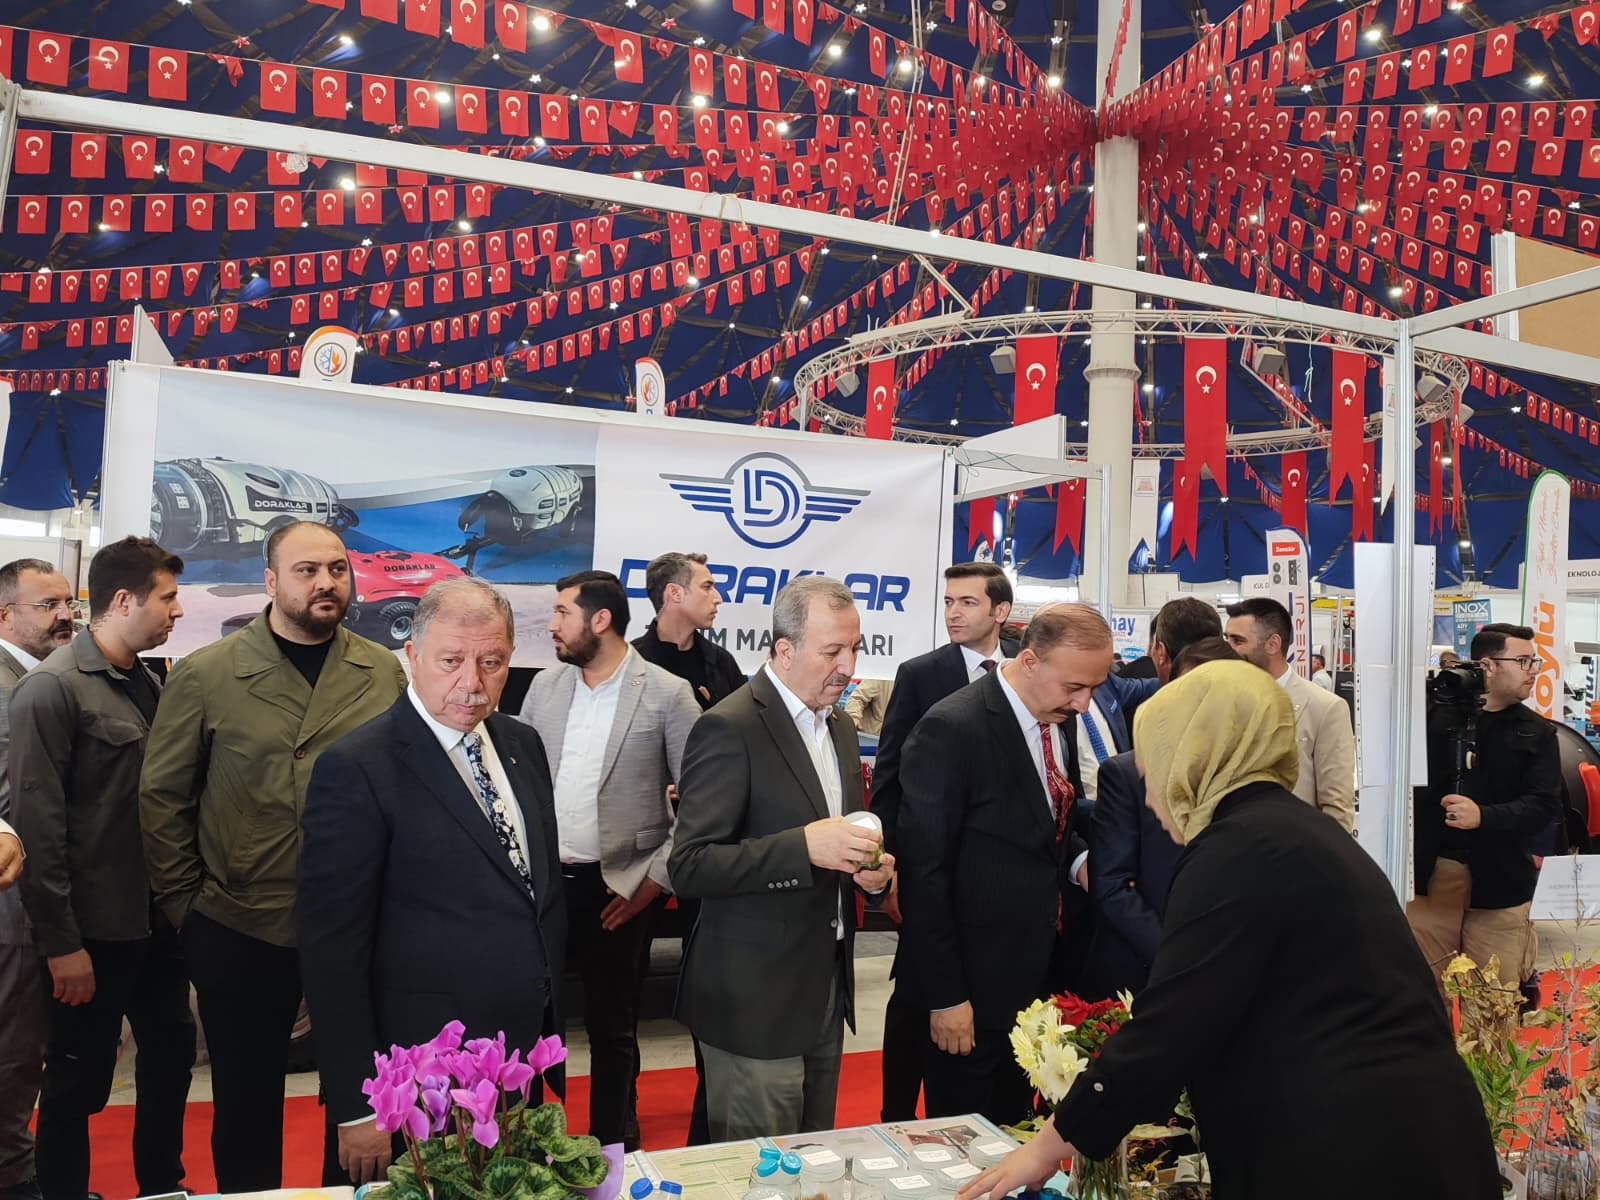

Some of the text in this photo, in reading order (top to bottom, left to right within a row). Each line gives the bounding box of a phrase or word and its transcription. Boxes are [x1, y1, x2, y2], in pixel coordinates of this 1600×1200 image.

[254, 499, 308, 510] DORAKLAR
[618, 558, 911, 612] DRAKAR
[1454, 601, 1488, 613] INOX
